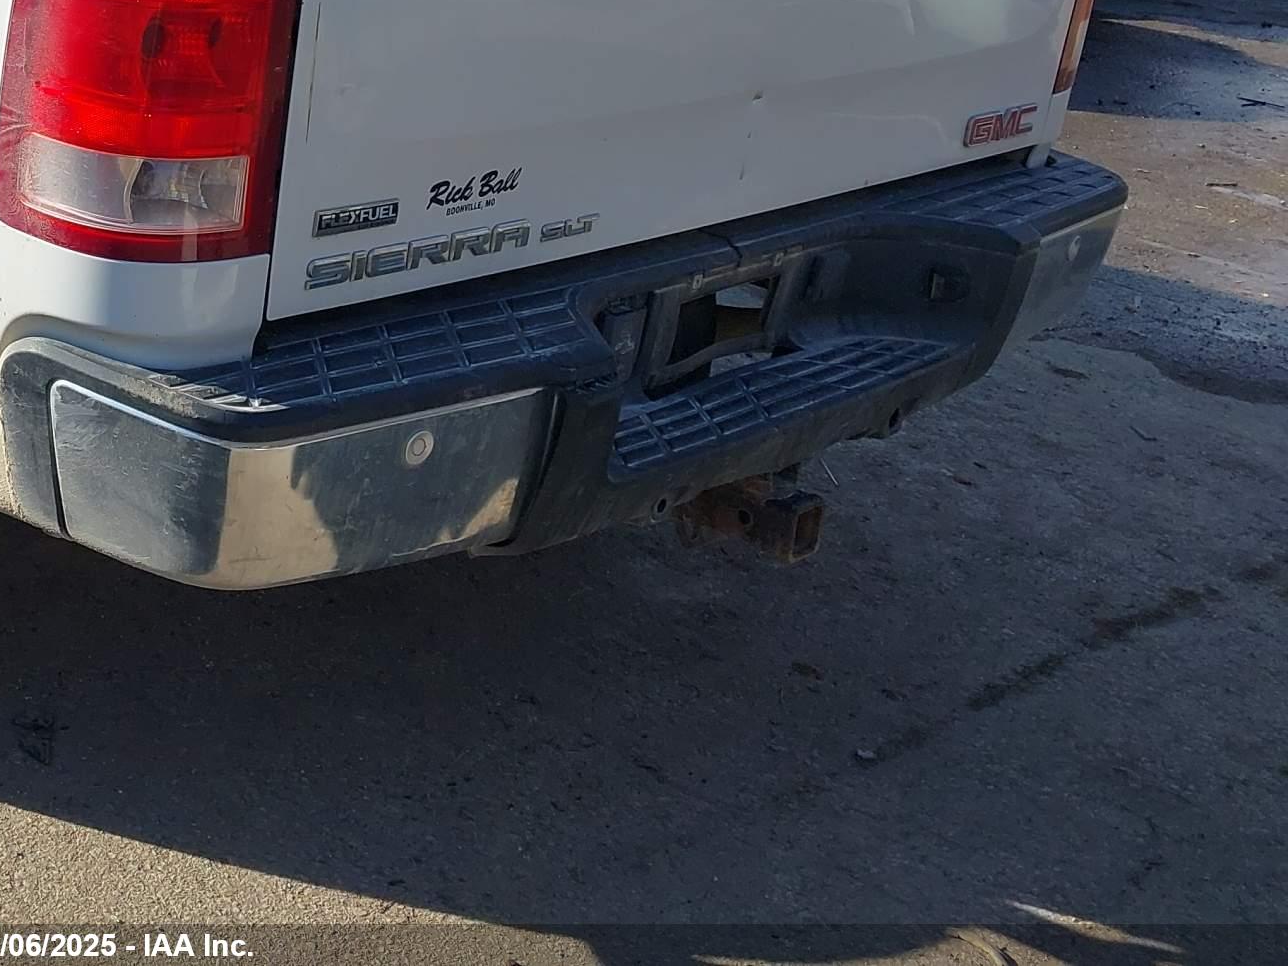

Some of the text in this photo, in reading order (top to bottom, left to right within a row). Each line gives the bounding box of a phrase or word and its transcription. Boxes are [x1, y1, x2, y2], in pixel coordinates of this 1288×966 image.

[963, 103, 1038, 147] GMC
[426, 167, 523, 210] Rick Ball
[485, 197, 496, 208] MO
[304, 212, 601, 290] SIERRA SLT
